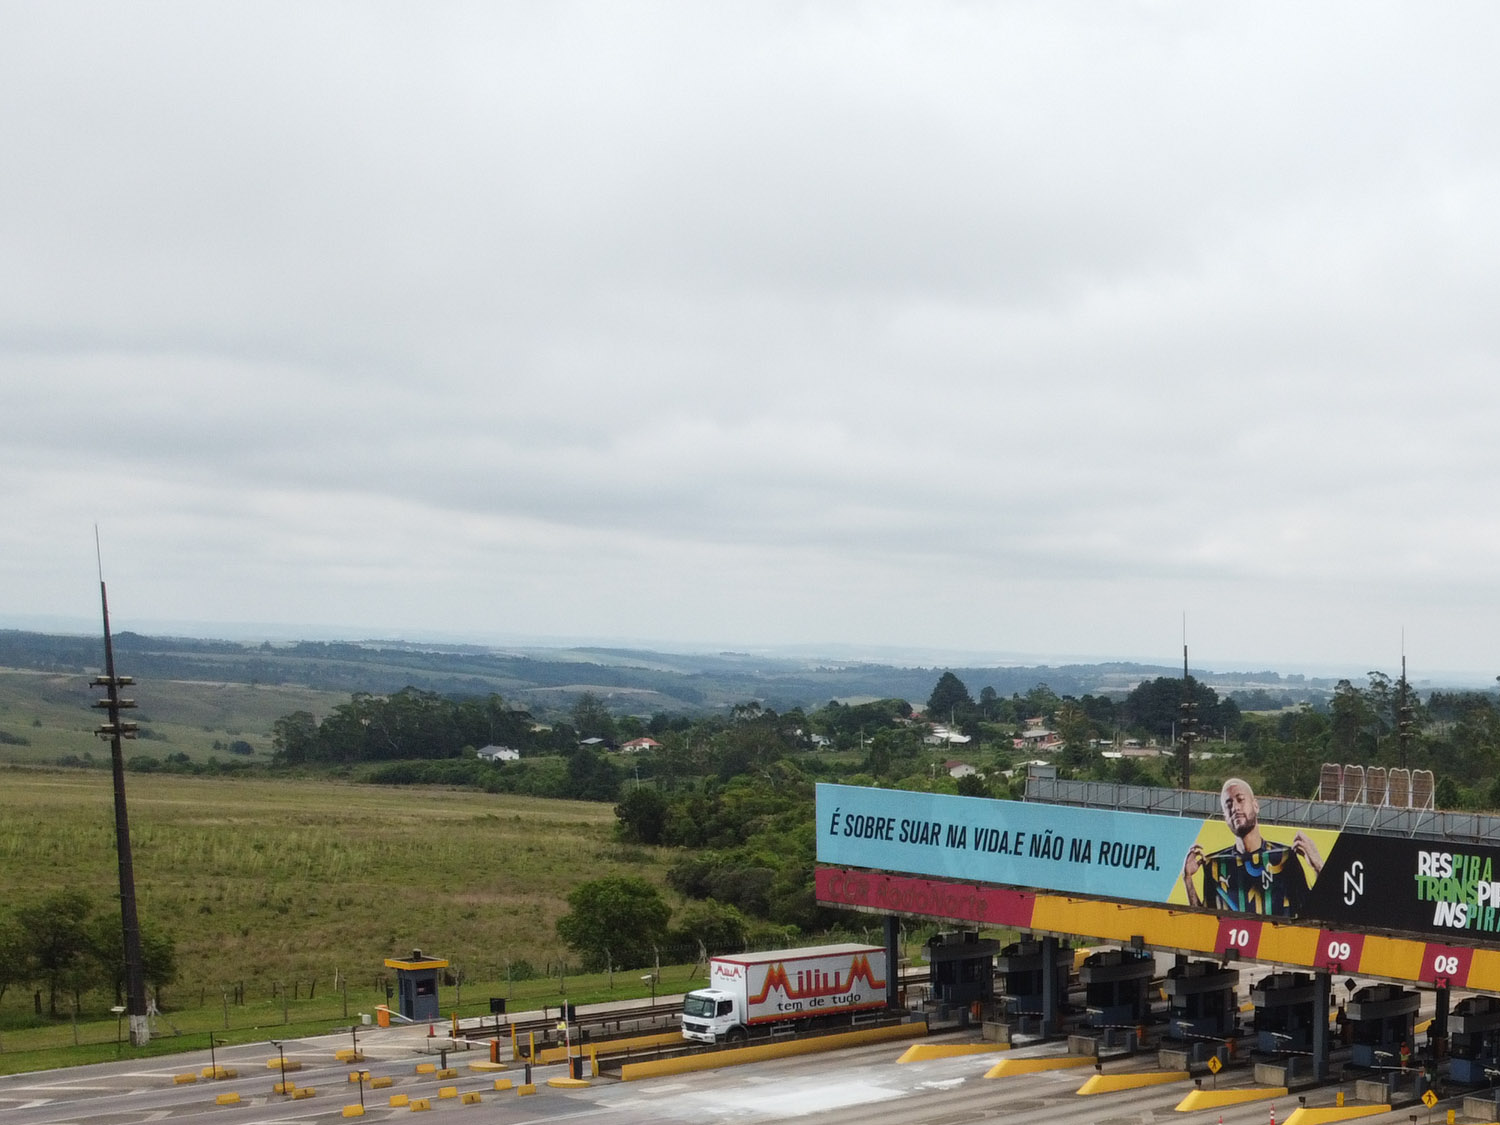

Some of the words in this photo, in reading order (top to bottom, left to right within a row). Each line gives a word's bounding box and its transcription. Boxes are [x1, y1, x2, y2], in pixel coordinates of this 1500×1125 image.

[830, 807, 841, 836] É
[844, 814, 896, 841] SOBRE
[899, 819, 942, 846] SUAR
[945, 824, 968, 850] NA
[1029, 829, 1064, 862] NÃO
[1069, 838, 1092, 864] NA
[1098, 841, 1160, 871] ROUPA.
[1228, 928, 1249, 947] 10
[1327, 941, 1351, 960] 09
[1434, 955, 1459, 975] 08
[777, 1001, 803, 1012] tem
[809, 997, 826, 1007] de
[831, 993, 861, 1005] tudo
